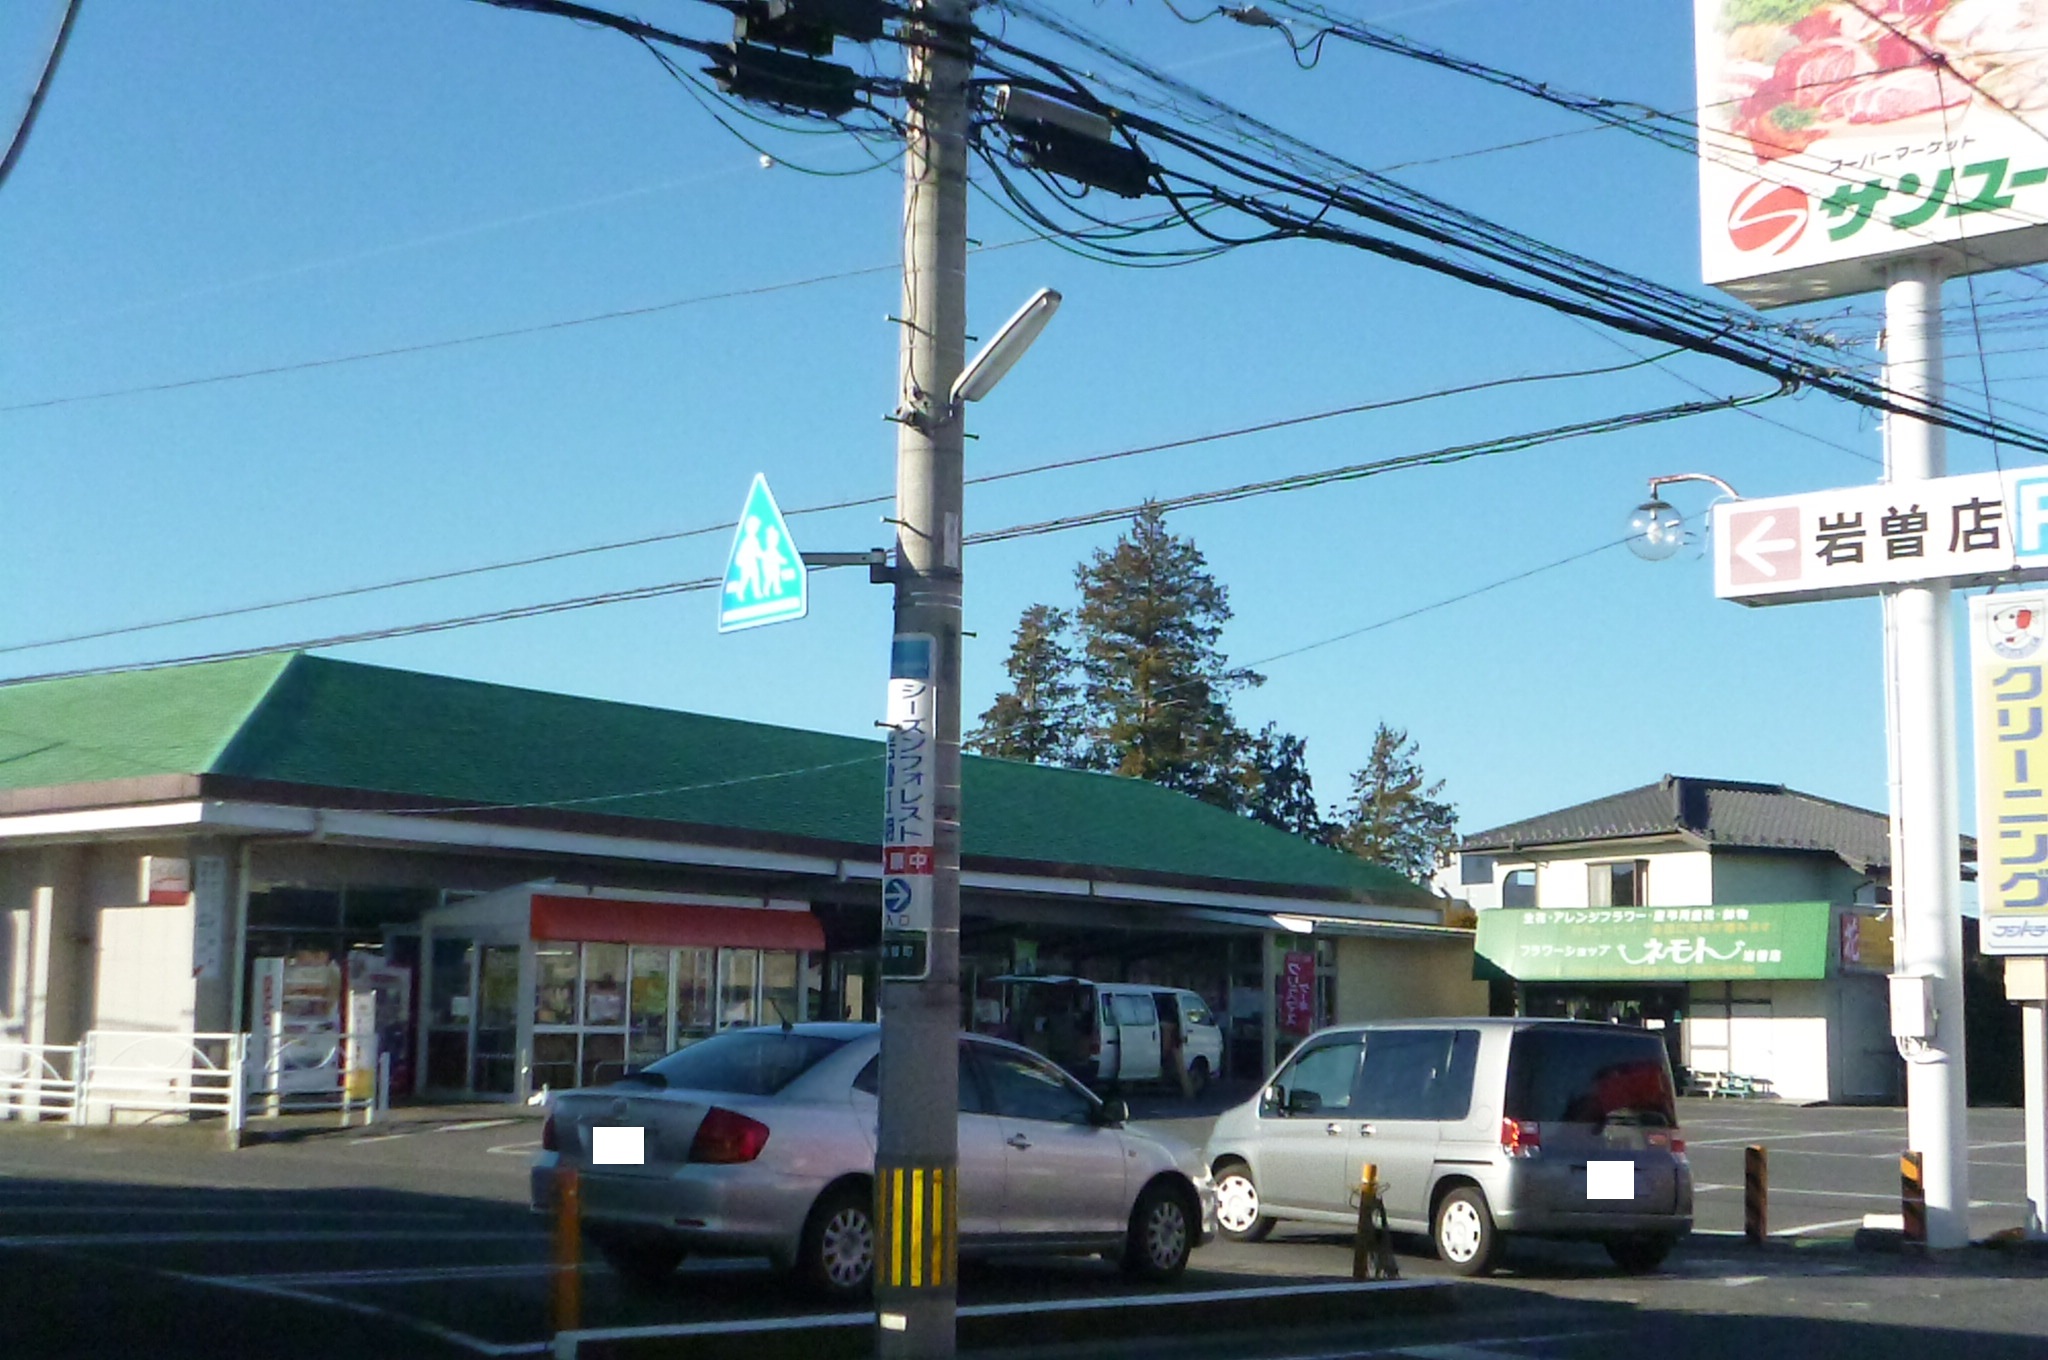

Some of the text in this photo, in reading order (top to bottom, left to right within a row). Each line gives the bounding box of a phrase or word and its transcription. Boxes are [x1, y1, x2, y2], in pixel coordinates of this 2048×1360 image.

[1829, 135, 1976, 174] スーパーマーケット
[1815, 496, 2004, 566] 岩曽店
[899, 683, 925, 842] シーズンフォレスト
[1993, 665, 2048, 908] クリーニング
[1520, 944, 1611, 958] フラワーショップ
[1625, 937, 1745, 966] ネモト
